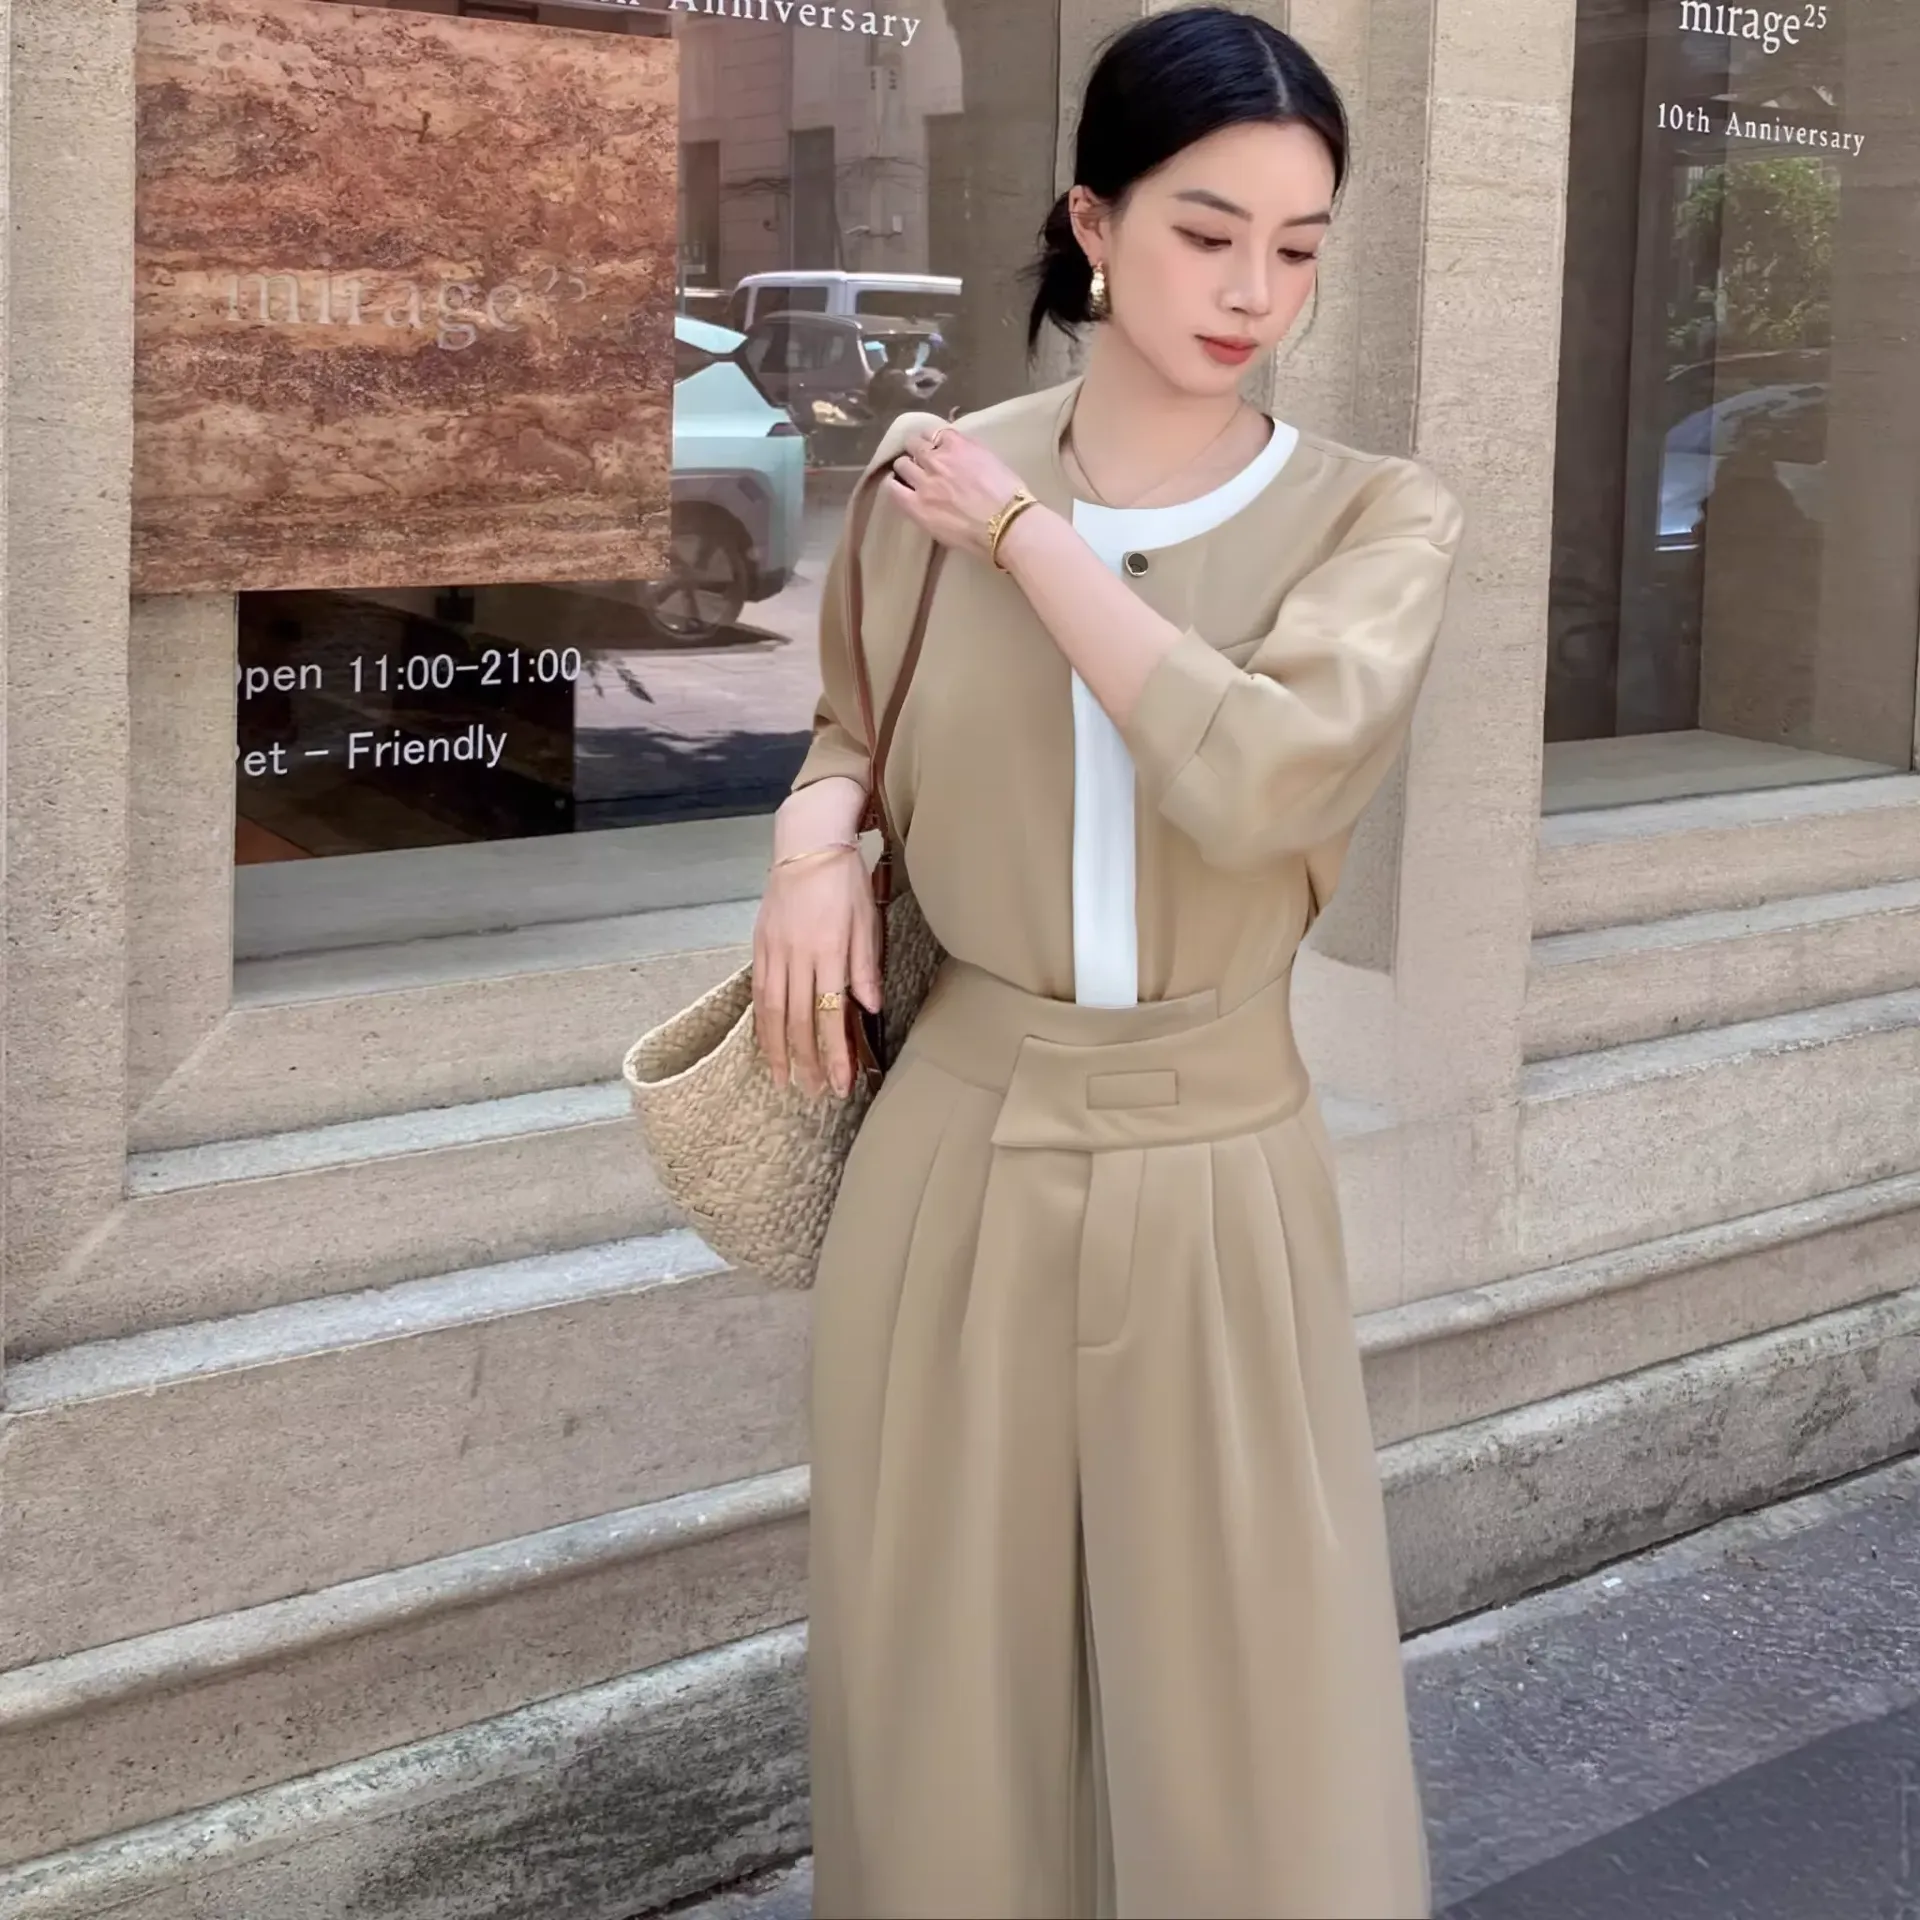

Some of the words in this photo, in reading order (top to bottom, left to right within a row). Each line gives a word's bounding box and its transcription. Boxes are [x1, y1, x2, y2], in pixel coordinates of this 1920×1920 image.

[1657, 103, 1710, 133] 10th
[1725, 112, 1865, 156] Anniversary
[349, 647, 582, 693] 11:00-21:00
[348, 724, 508, 769] Friendly
